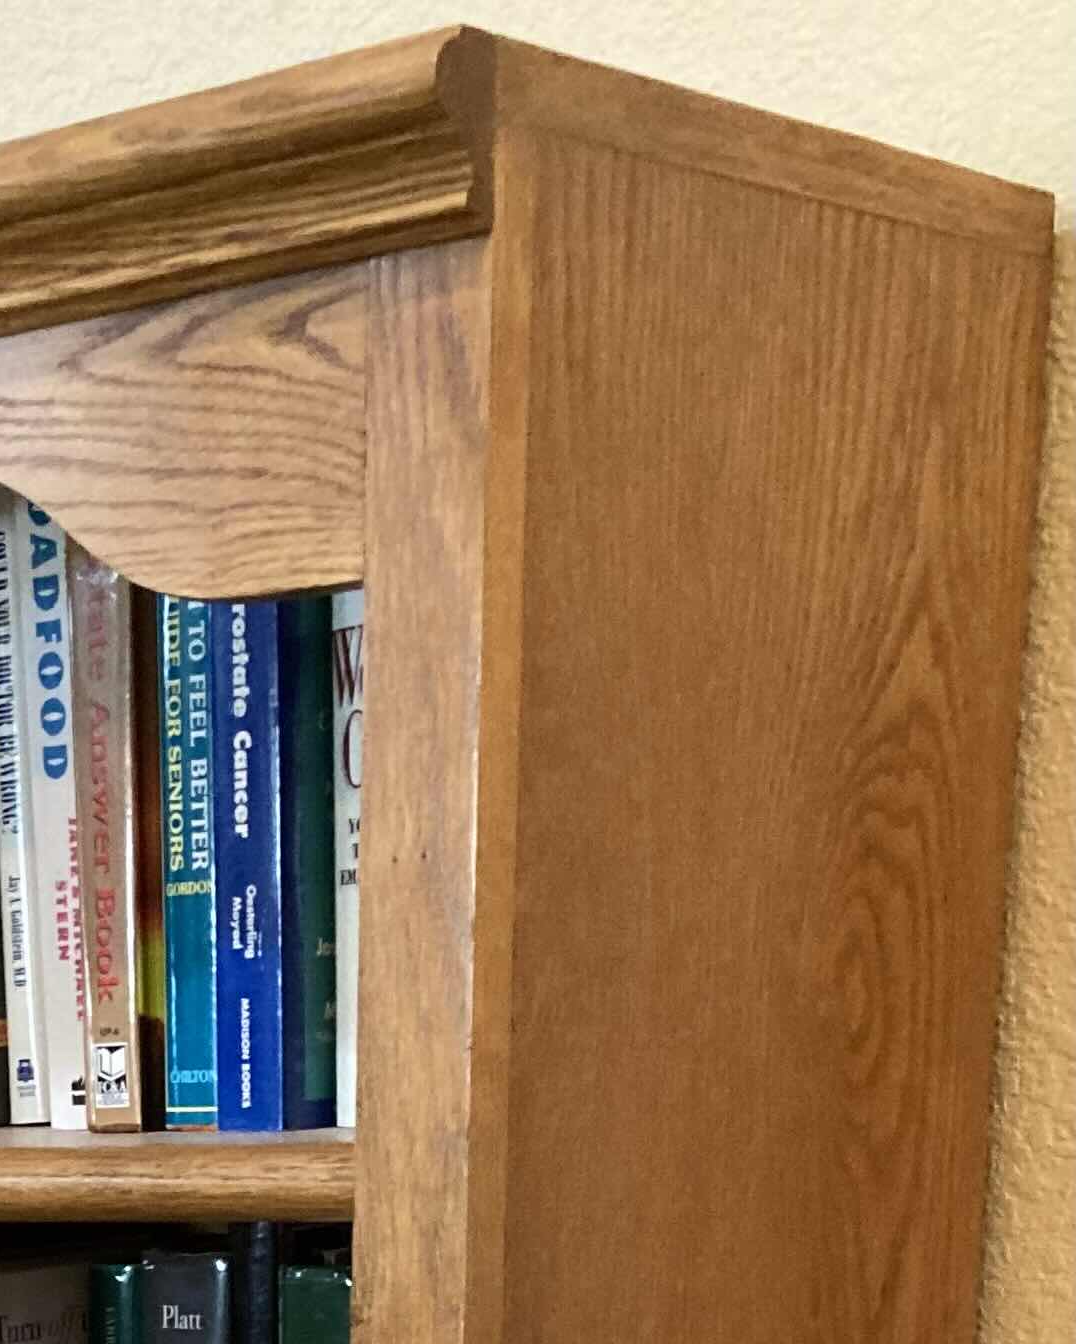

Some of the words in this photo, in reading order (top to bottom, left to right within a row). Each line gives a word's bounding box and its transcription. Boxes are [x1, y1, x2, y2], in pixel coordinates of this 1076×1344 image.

[187, 621, 206, 661] TO
[165, 678, 182, 739] FOR
[188, 674, 207, 747] FEEL
[91, 703, 110, 875] Answer
[168, 746, 184, 871] SENIORS
[189, 757, 209, 870] BETTER
[55, 880, 71, 961] STERN
[166, 882, 213, 896] GORDON
[95, 888, 119, 1004] Book
[241, 998, 251, 1060] MADISON
[242, 1063, 252, 1109] BOOKS
[162, 1304, 203, 1330] Platt
